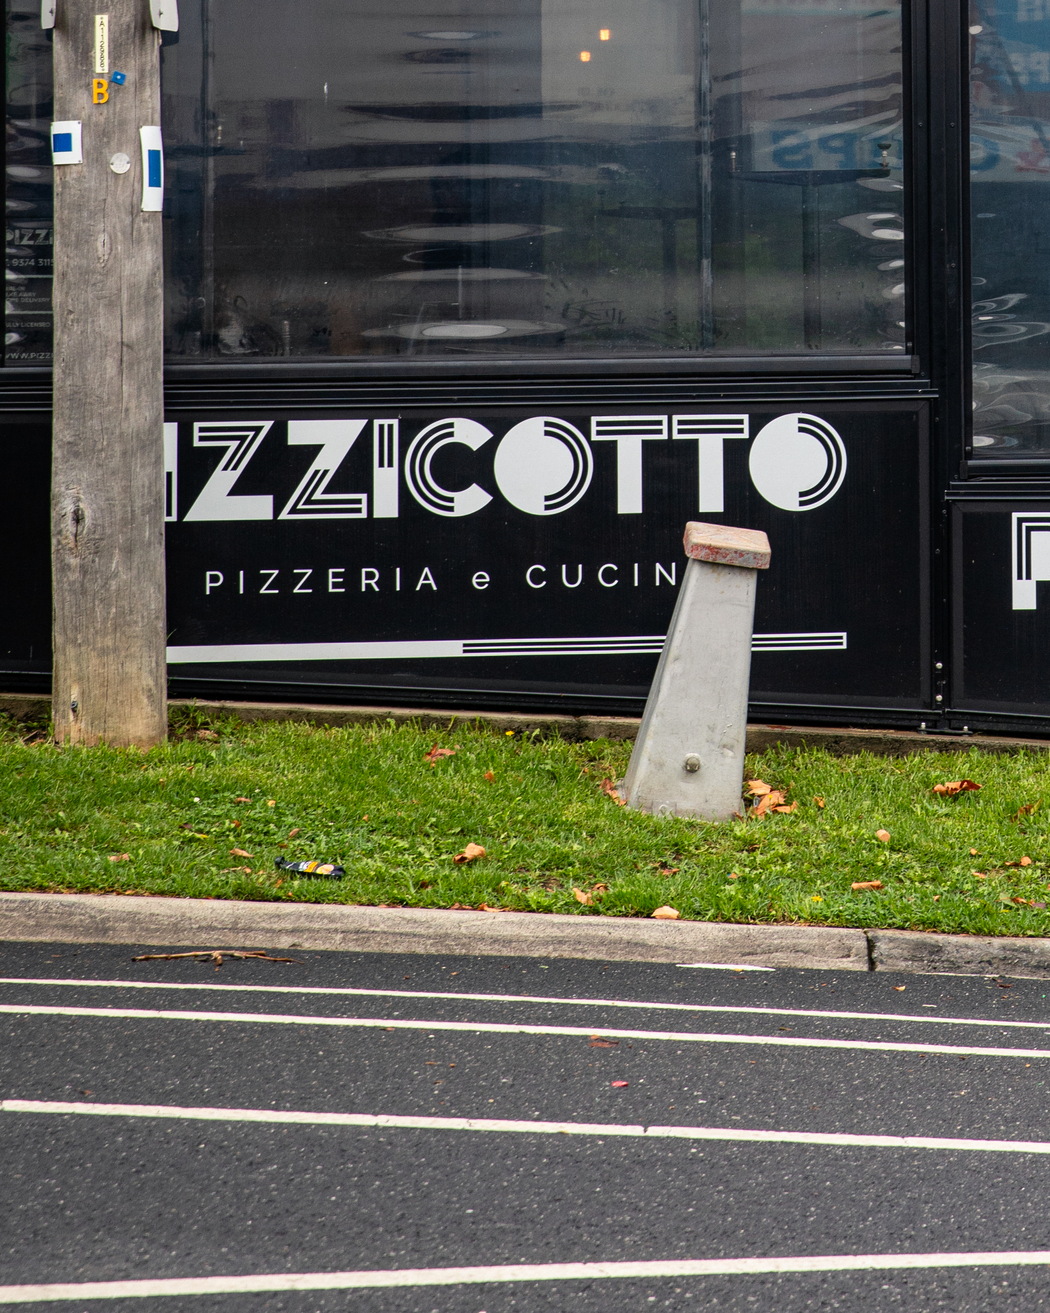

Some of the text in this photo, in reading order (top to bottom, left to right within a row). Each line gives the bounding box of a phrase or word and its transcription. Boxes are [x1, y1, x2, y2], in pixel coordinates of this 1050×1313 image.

[92, 78, 109, 104] B
[163, 412, 848, 522] IZZICOTTO
[205, 562, 678, 595] PIZZERIA e CUCIN
